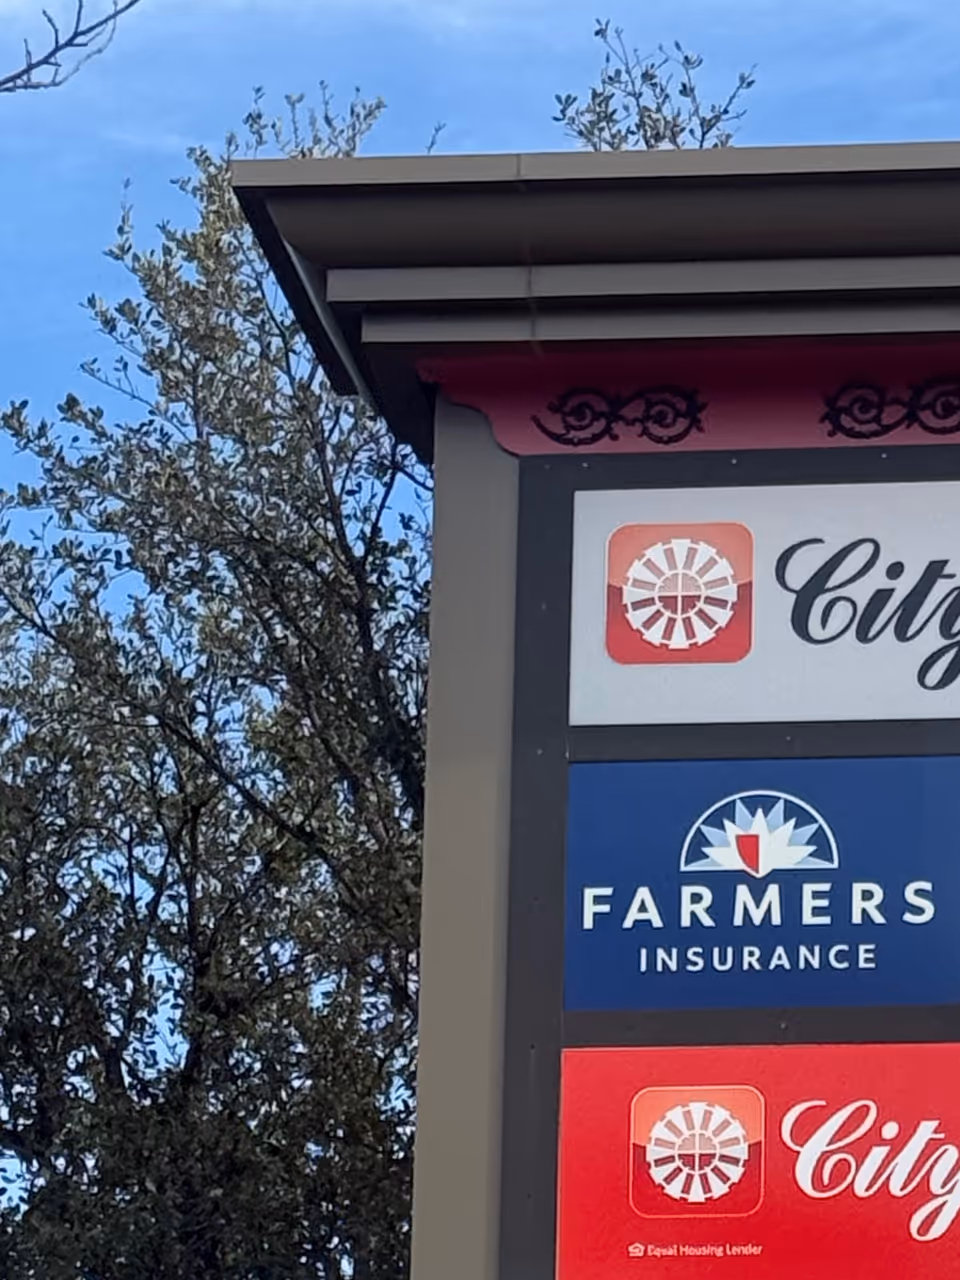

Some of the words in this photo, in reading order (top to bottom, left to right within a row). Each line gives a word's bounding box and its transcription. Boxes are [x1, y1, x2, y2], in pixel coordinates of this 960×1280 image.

[583, 880, 935, 930] FARMERS
[640, 943, 877, 972] INSURANCE
[647, 1243, 678, 1258] Equal
[679, 1243, 724, 1257] Housing
[725, 1242, 763, 1256] Lender
